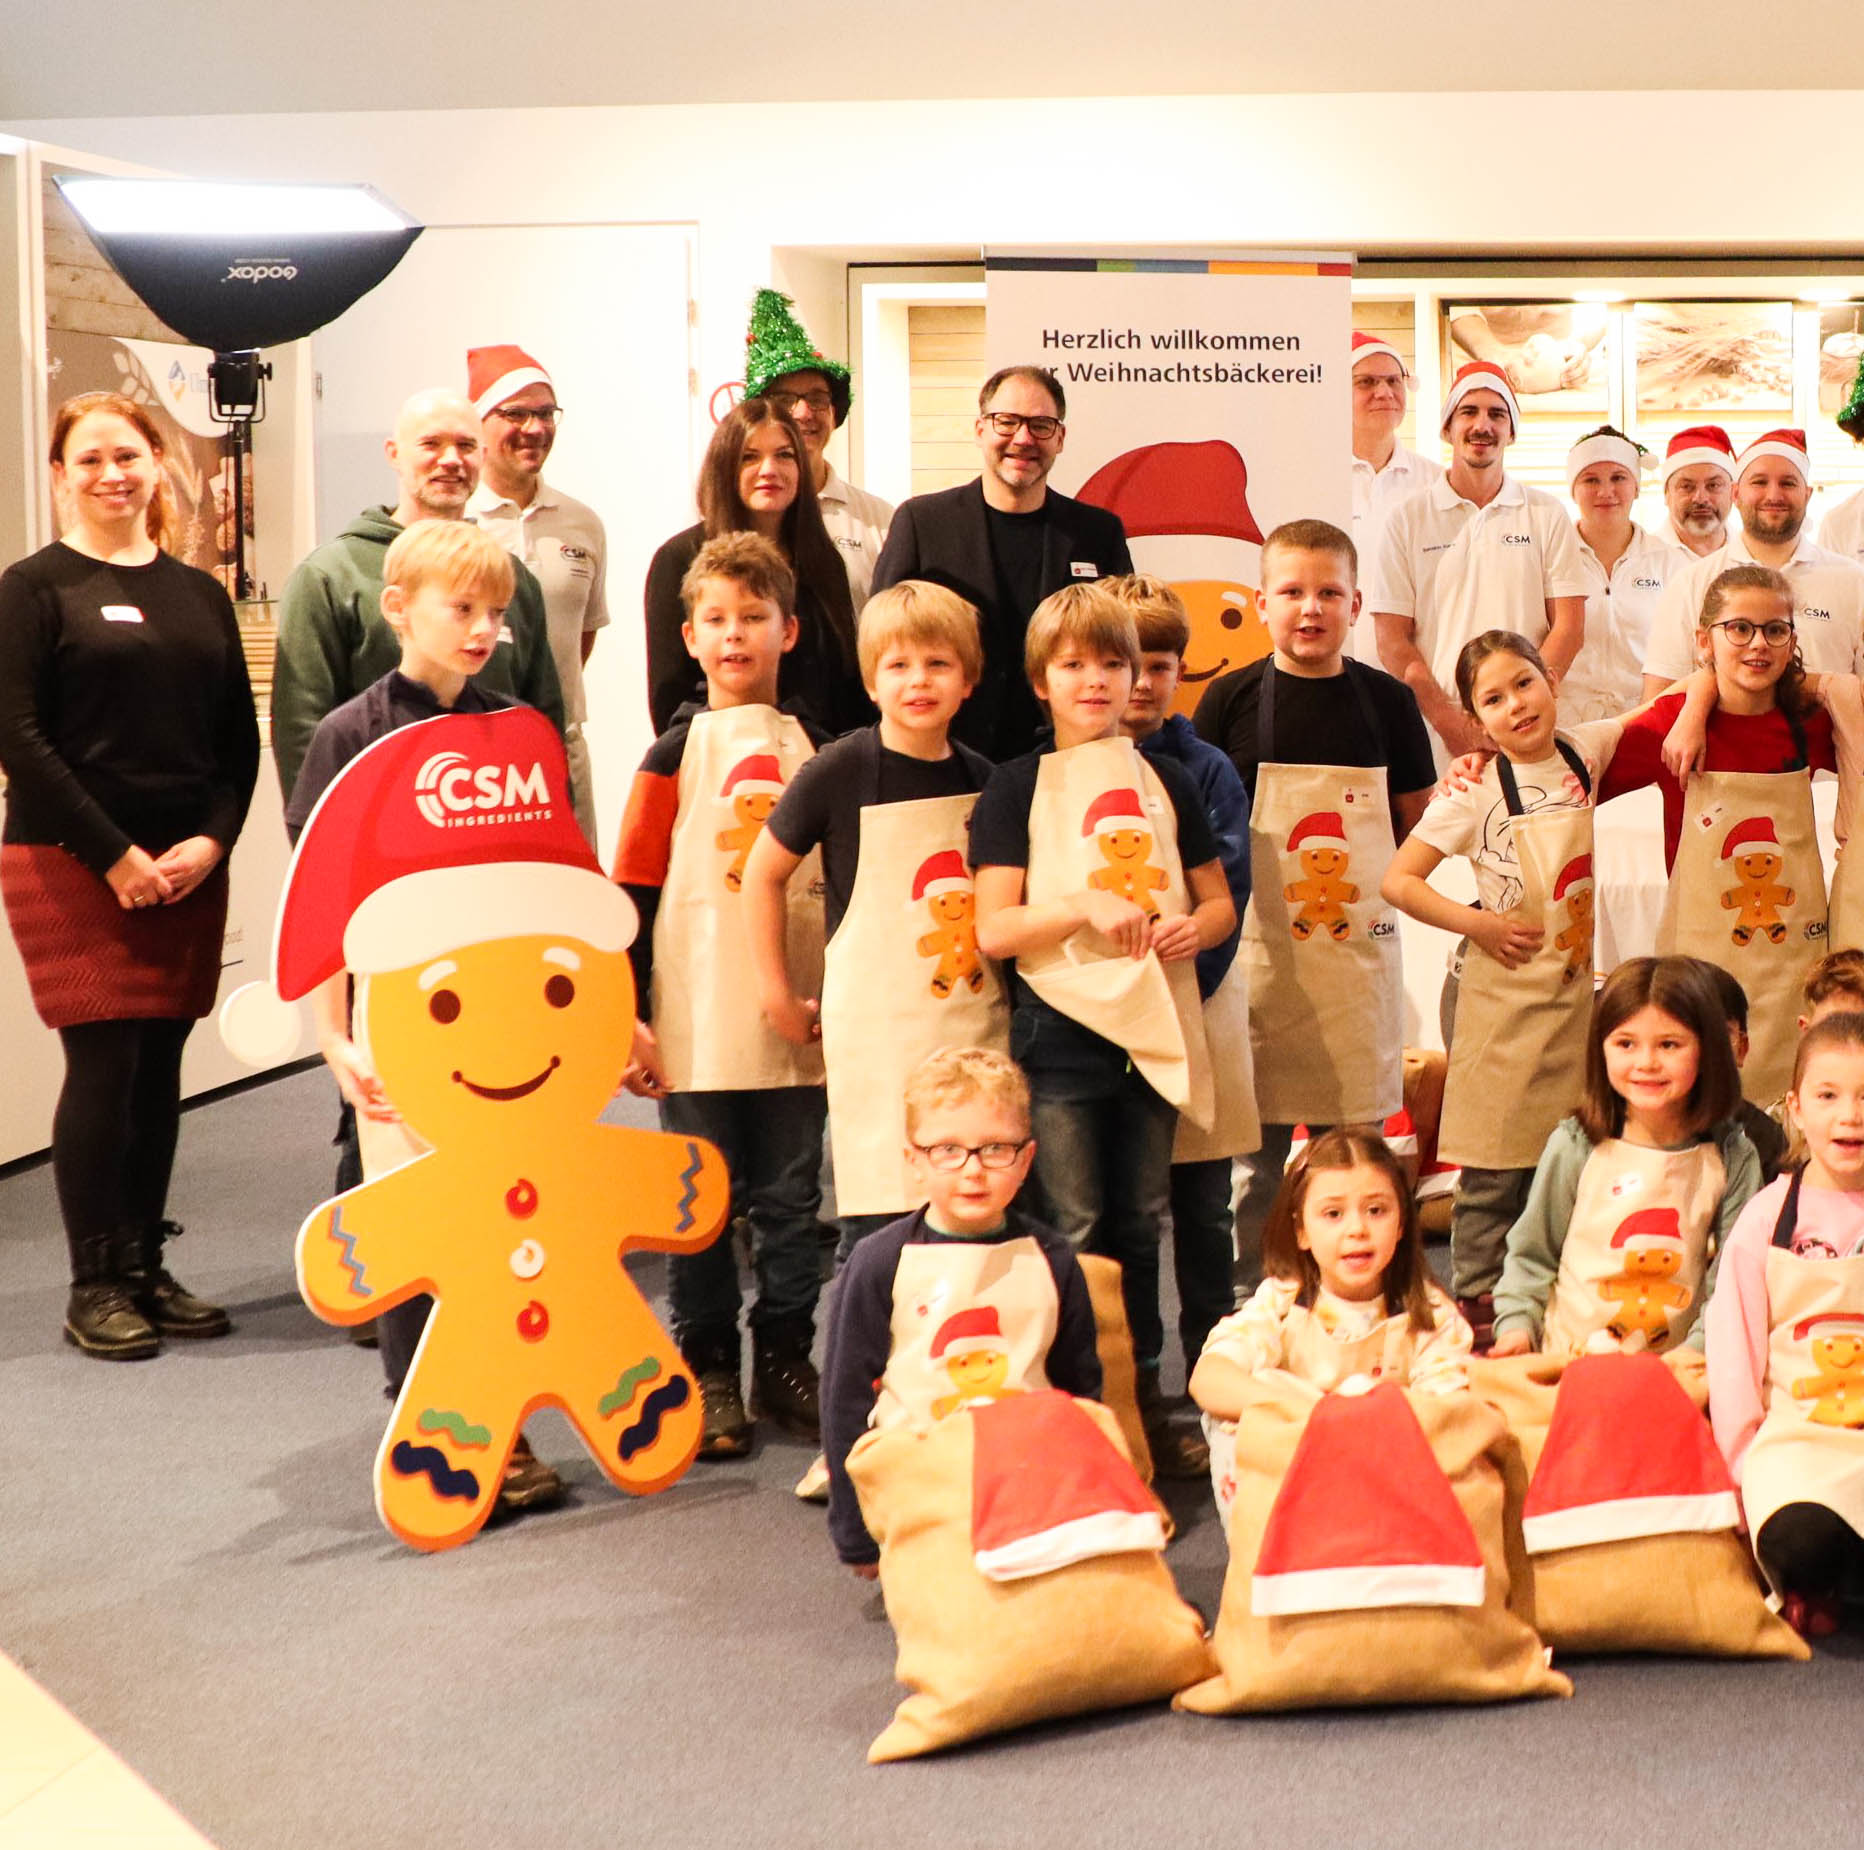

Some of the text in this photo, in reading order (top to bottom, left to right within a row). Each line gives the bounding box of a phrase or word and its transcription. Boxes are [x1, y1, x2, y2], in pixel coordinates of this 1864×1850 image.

[226, 265, 298, 284] Godox
[1042, 328, 1301, 351] Herzlich willkommen
[1066, 361, 1323, 384] Weihnachtsbäckerei!
[1505, 535, 1531, 544] CSM
[1804, 607, 1830, 619] CSM
[439, 761, 552, 812] CSM
[447, 809, 553, 828] INGREDIENTS
[1373, 922, 1395, 936] CSM
